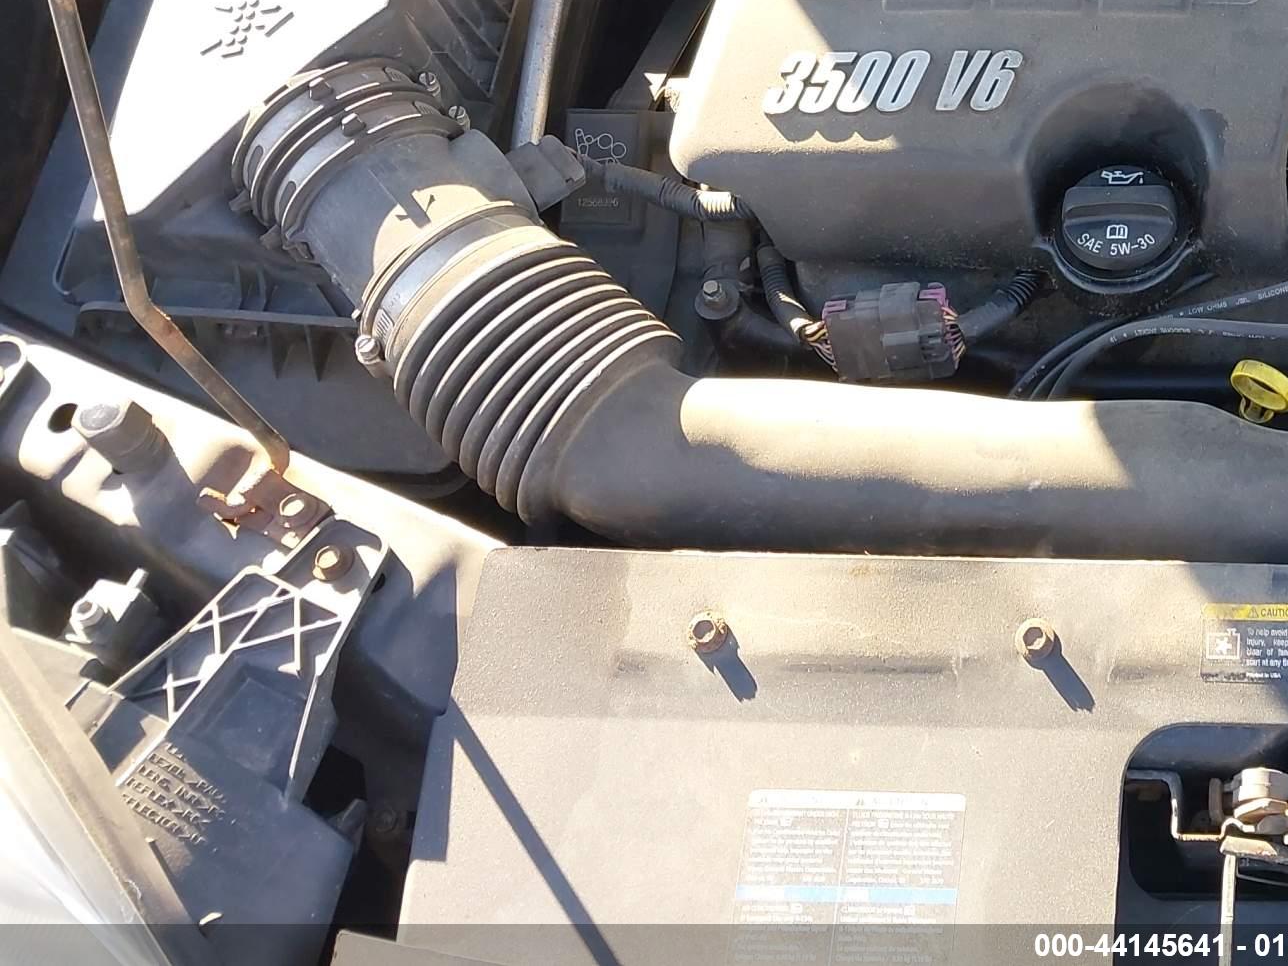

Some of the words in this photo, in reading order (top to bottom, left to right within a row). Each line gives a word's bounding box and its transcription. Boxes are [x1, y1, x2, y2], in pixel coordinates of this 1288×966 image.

[761, 49, 931, 114] 3500
[935, 49, 1024, 112] V6
[1077, 233, 1104, 253] SAE
[1110, 233, 1156, 255] 5W-30
